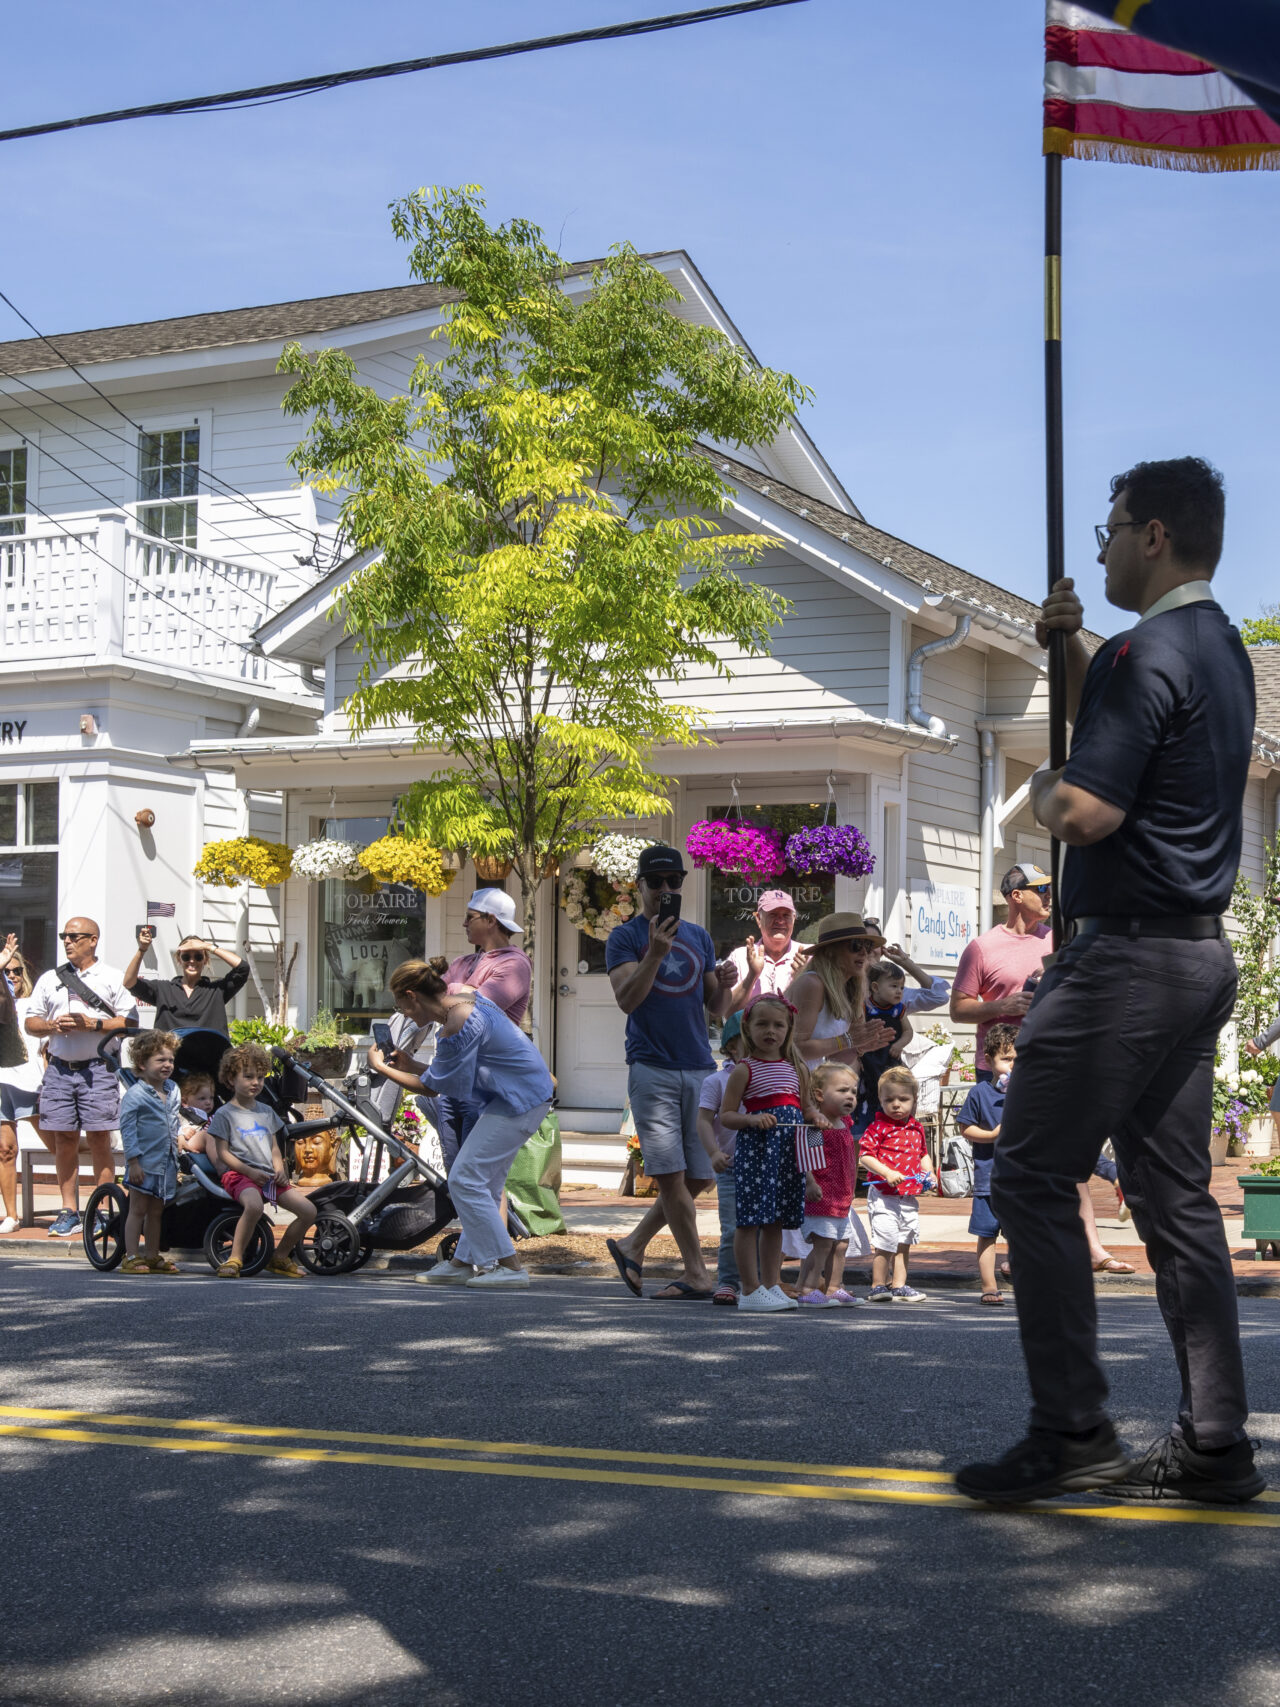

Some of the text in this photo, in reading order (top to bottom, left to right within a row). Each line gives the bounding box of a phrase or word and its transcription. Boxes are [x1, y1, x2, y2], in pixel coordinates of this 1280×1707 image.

[0, 720, 27, 744] RY
[334, 893, 418, 909] TOPIAIRE
[724, 886, 821, 903] TOPIRE
[343, 912, 408, 926] Fresh Flowers
[918, 906, 946, 940] Candy
[351, 945, 388, 960] LOCA
